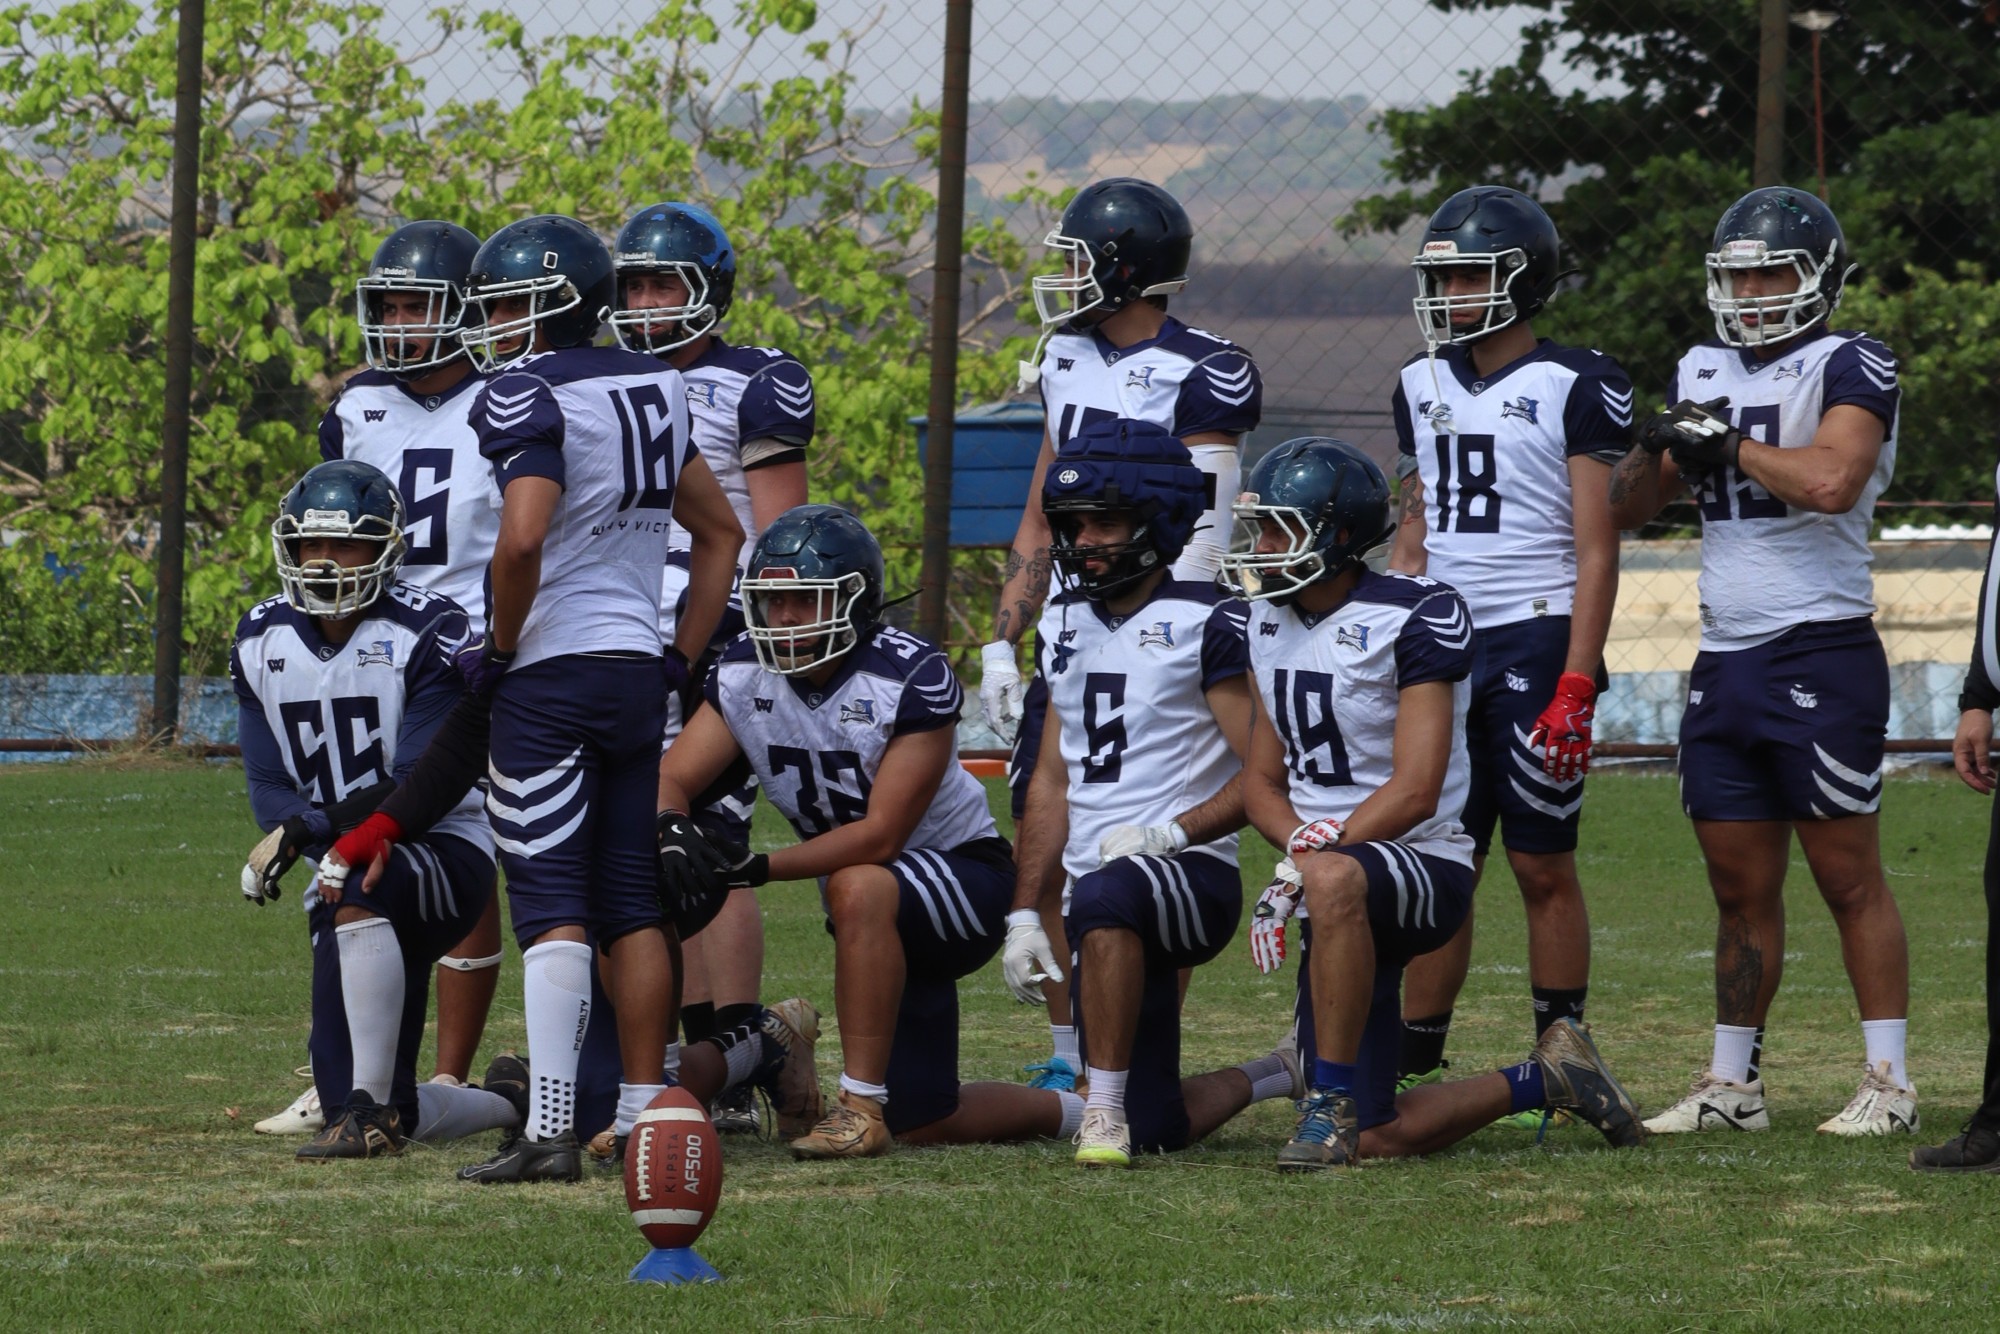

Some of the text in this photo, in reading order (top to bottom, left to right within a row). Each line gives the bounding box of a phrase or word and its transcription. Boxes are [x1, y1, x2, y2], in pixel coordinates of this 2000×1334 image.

[607, 383, 676, 512] 16
[1435, 433, 1502, 534] 18
[399, 448, 454, 567] 5
[1274, 668, 1359, 788] 19
[573, 999, 590, 1052] PENALTY
[665, 1133, 680, 1193] KIPSTA
[684, 1134, 702, 1195] AF500
